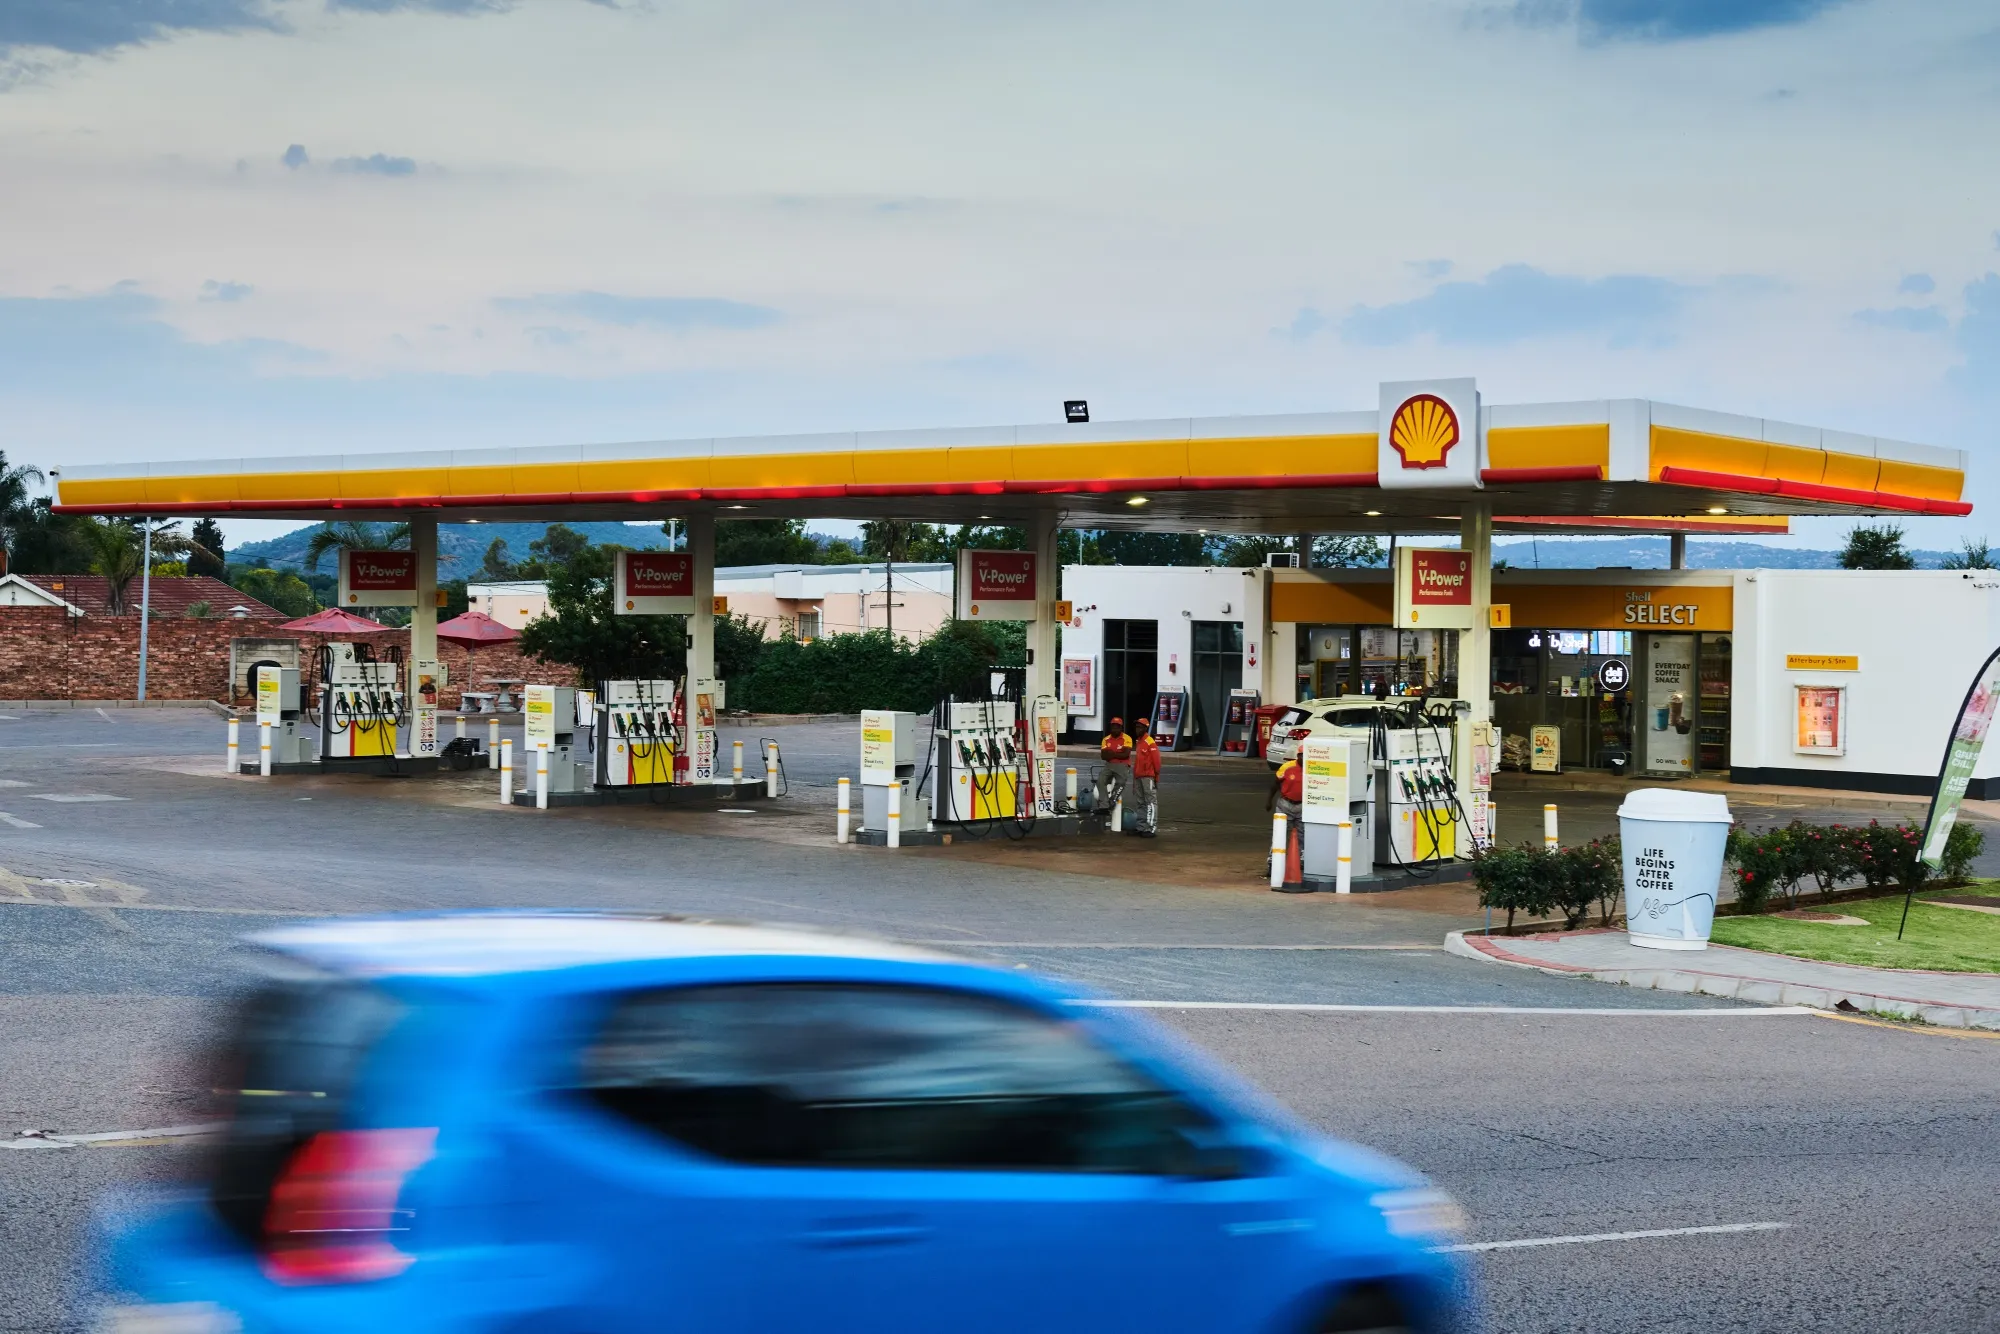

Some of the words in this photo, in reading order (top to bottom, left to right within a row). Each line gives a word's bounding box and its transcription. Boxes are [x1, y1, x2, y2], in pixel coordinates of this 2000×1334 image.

[357, 565, 408, 577] V-Power
[634, 568, 684, 581] V-Power
[979, 569, 1028, 584] V-Power
[1418, 570, 1464, 586] V-Power
[1626, 592, 1650, 601] Shell
[714, 601, 720, 610] 5
[1060, 606, 1066, 616] 3
[1496, 610, 1502, 622] 1
[1625, 604, 1698, 624] SELECT
[1550, 634, 1562, 651] by
[1605, 667, 1623, 676] deli
[1643, 848, 1664, 858] LIFE
[1635, 857, 1675, 870] BEGINS
[1639, 869, 1670, 880] AFTER
[1636, 878, 1674, 890] COFFEE
